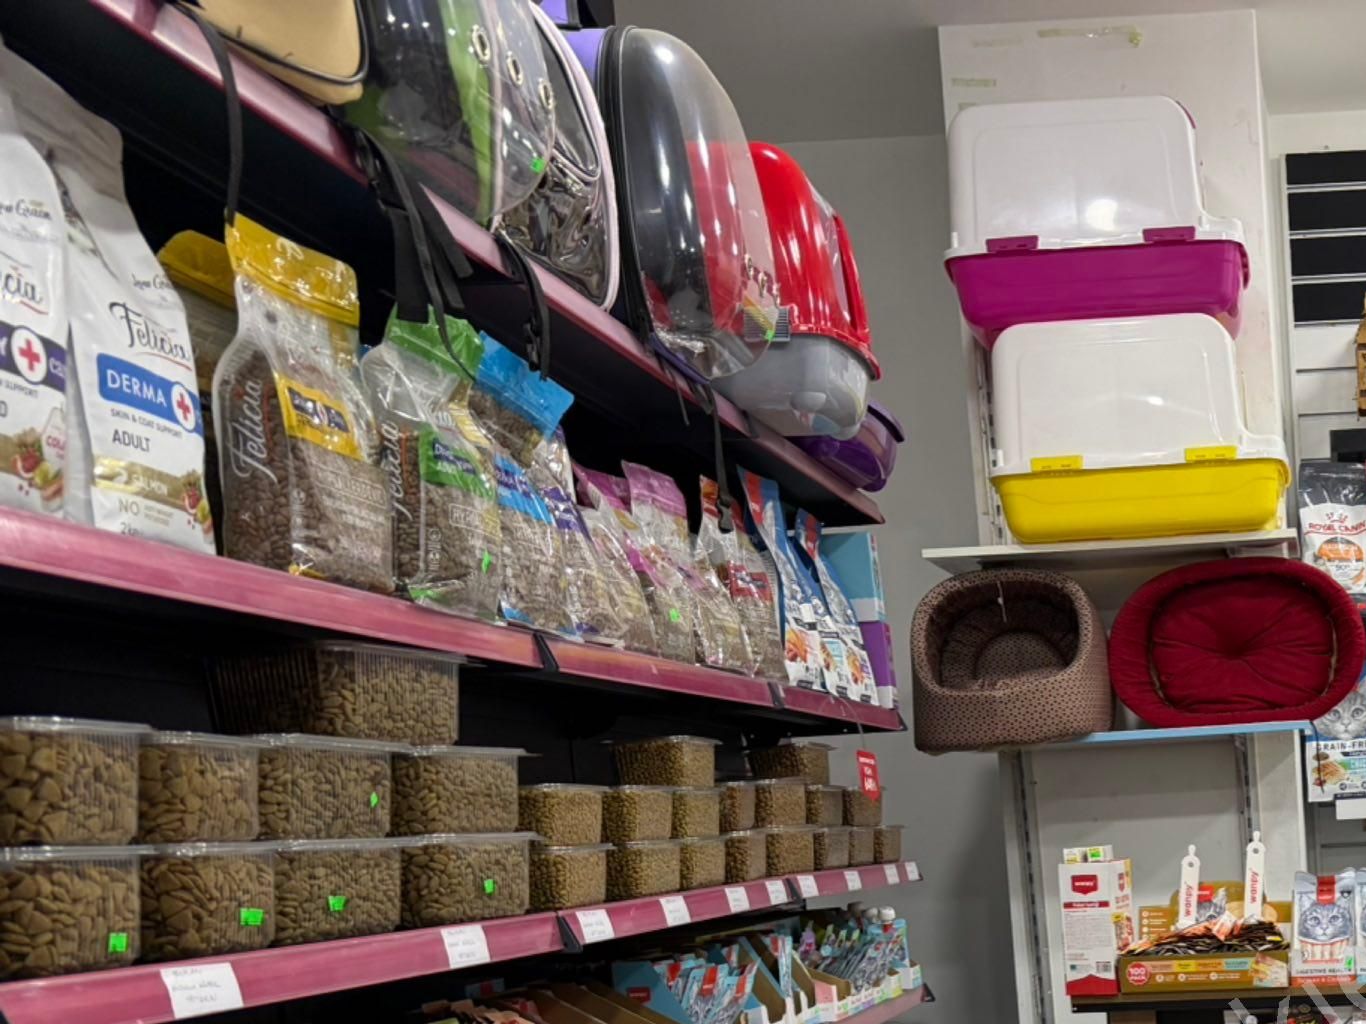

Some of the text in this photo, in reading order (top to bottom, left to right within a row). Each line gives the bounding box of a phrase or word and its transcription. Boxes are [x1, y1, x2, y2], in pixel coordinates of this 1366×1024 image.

[109, 301, 192, 364] Felicia
[106, 369, 168, 408] DERMA
[112, 427, 152, 453] ADULT
[119, 498, 141, 517] NO
[1308, 520, 1366, 533] ROYAL CANIN
[1183, 883, 1195, 918] wanpy
[1249, 870, 1260, 904] wanpy
